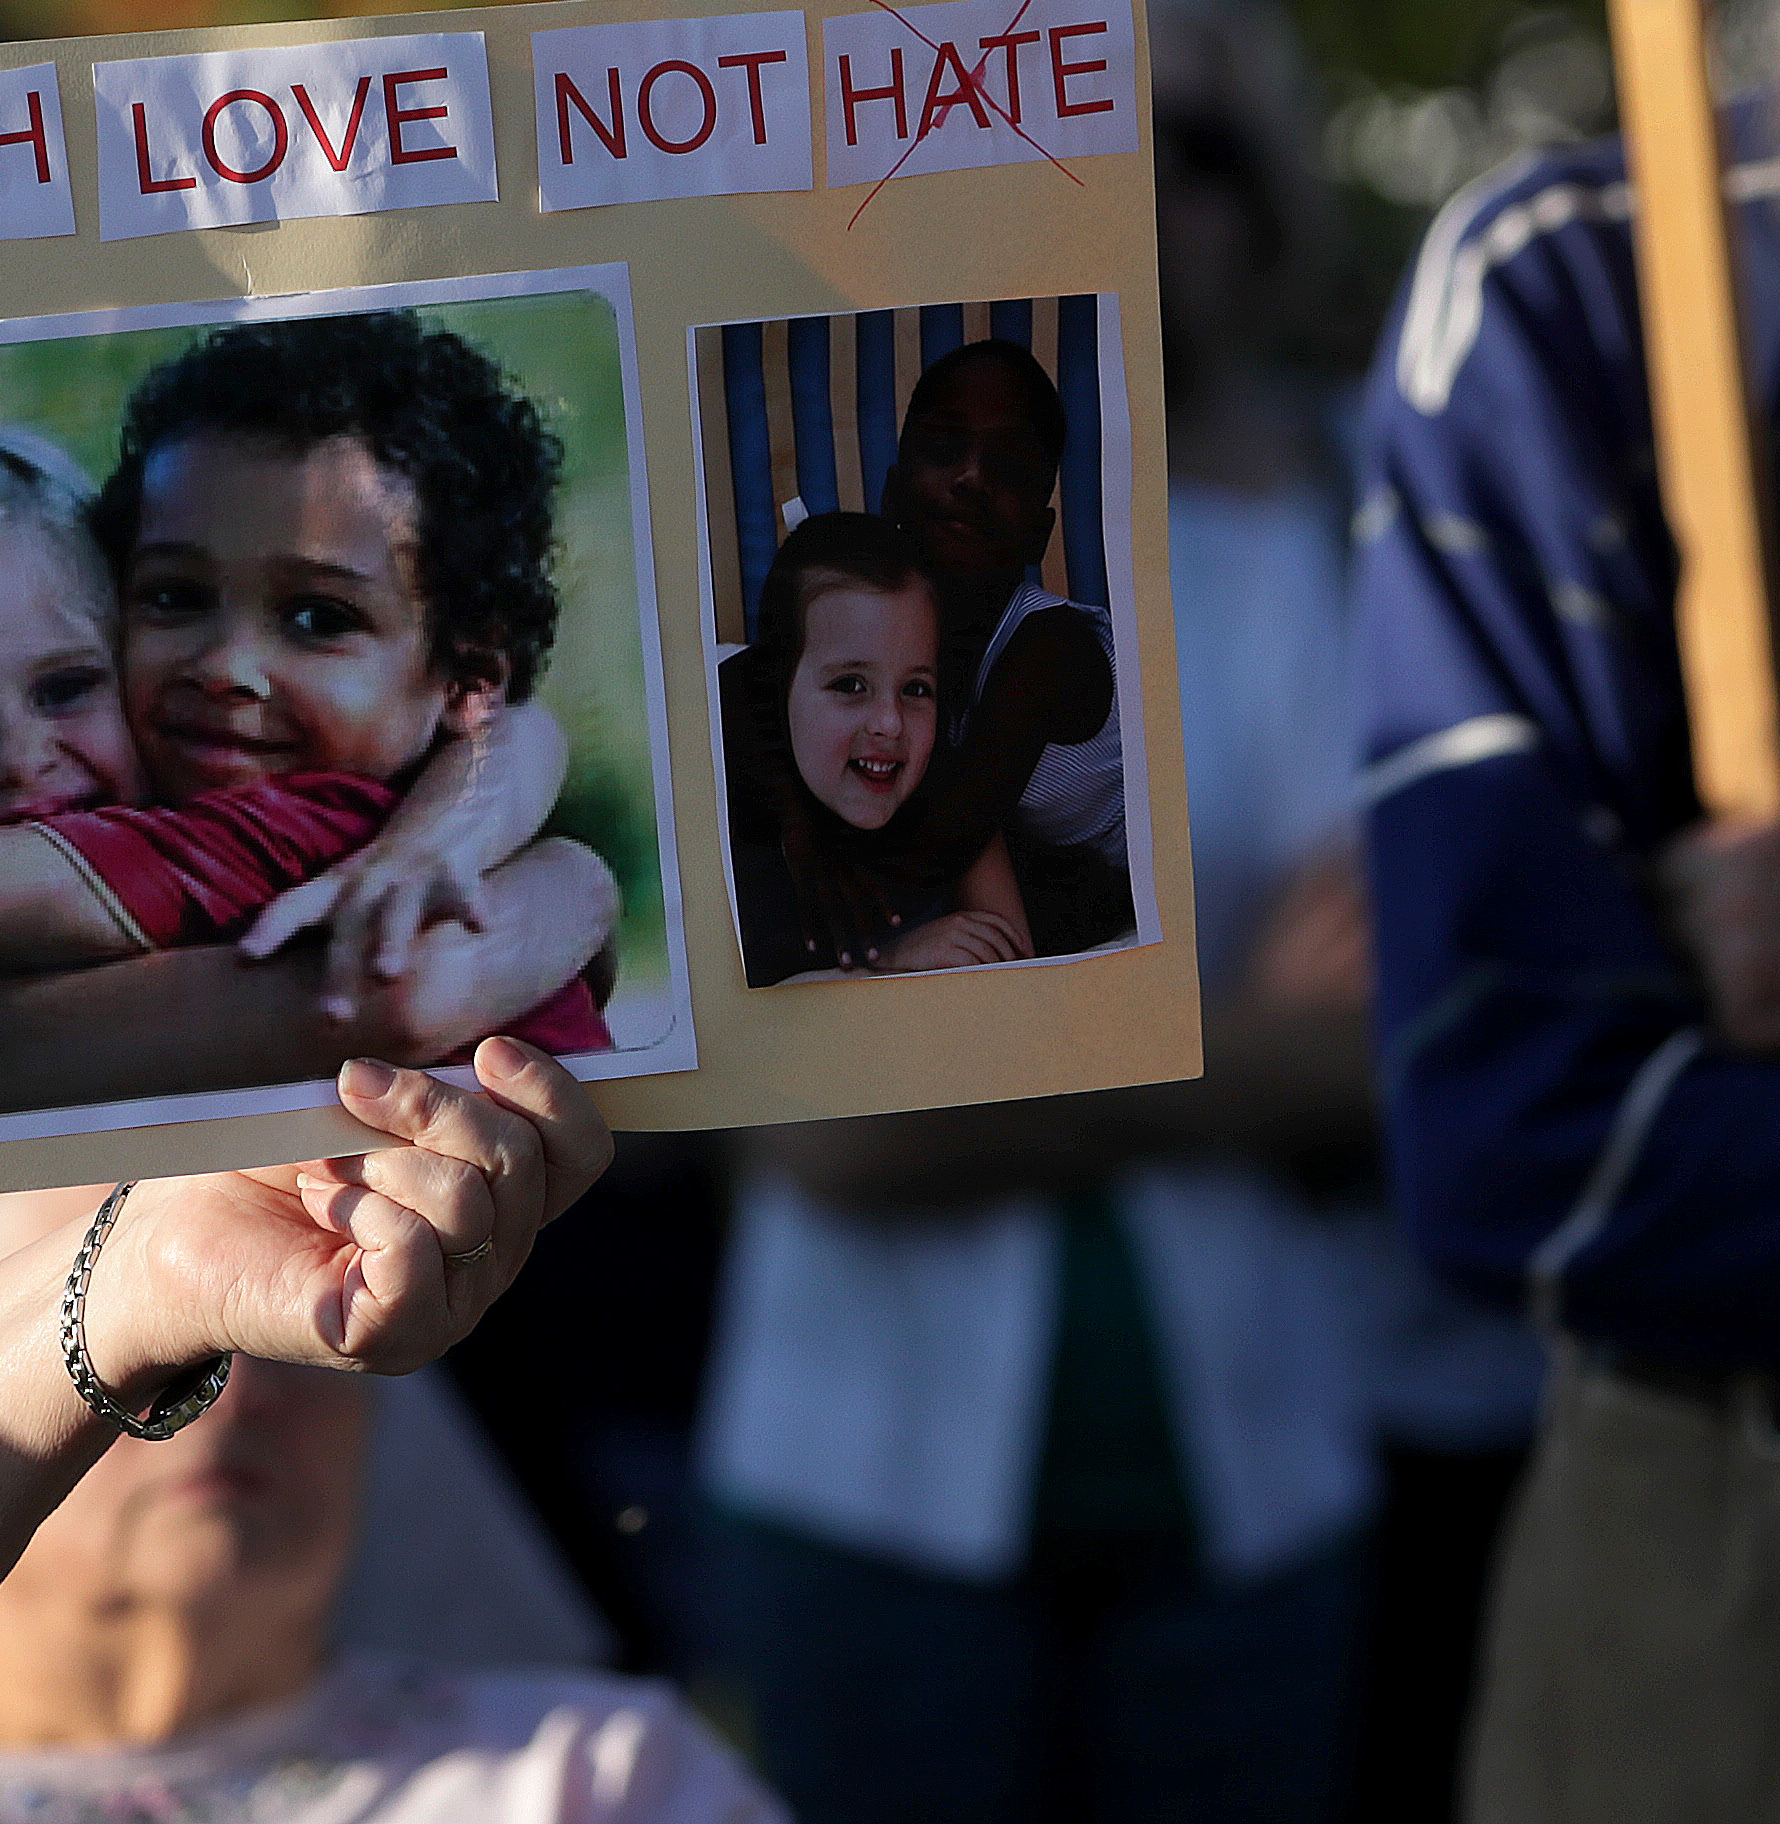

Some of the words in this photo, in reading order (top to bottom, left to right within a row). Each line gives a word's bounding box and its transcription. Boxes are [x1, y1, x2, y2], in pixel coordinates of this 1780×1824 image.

[132, 67, 458, 195] LOVE
[555, 50, 787, 166] NOT
[837, 20, 1115, 146] HATE
